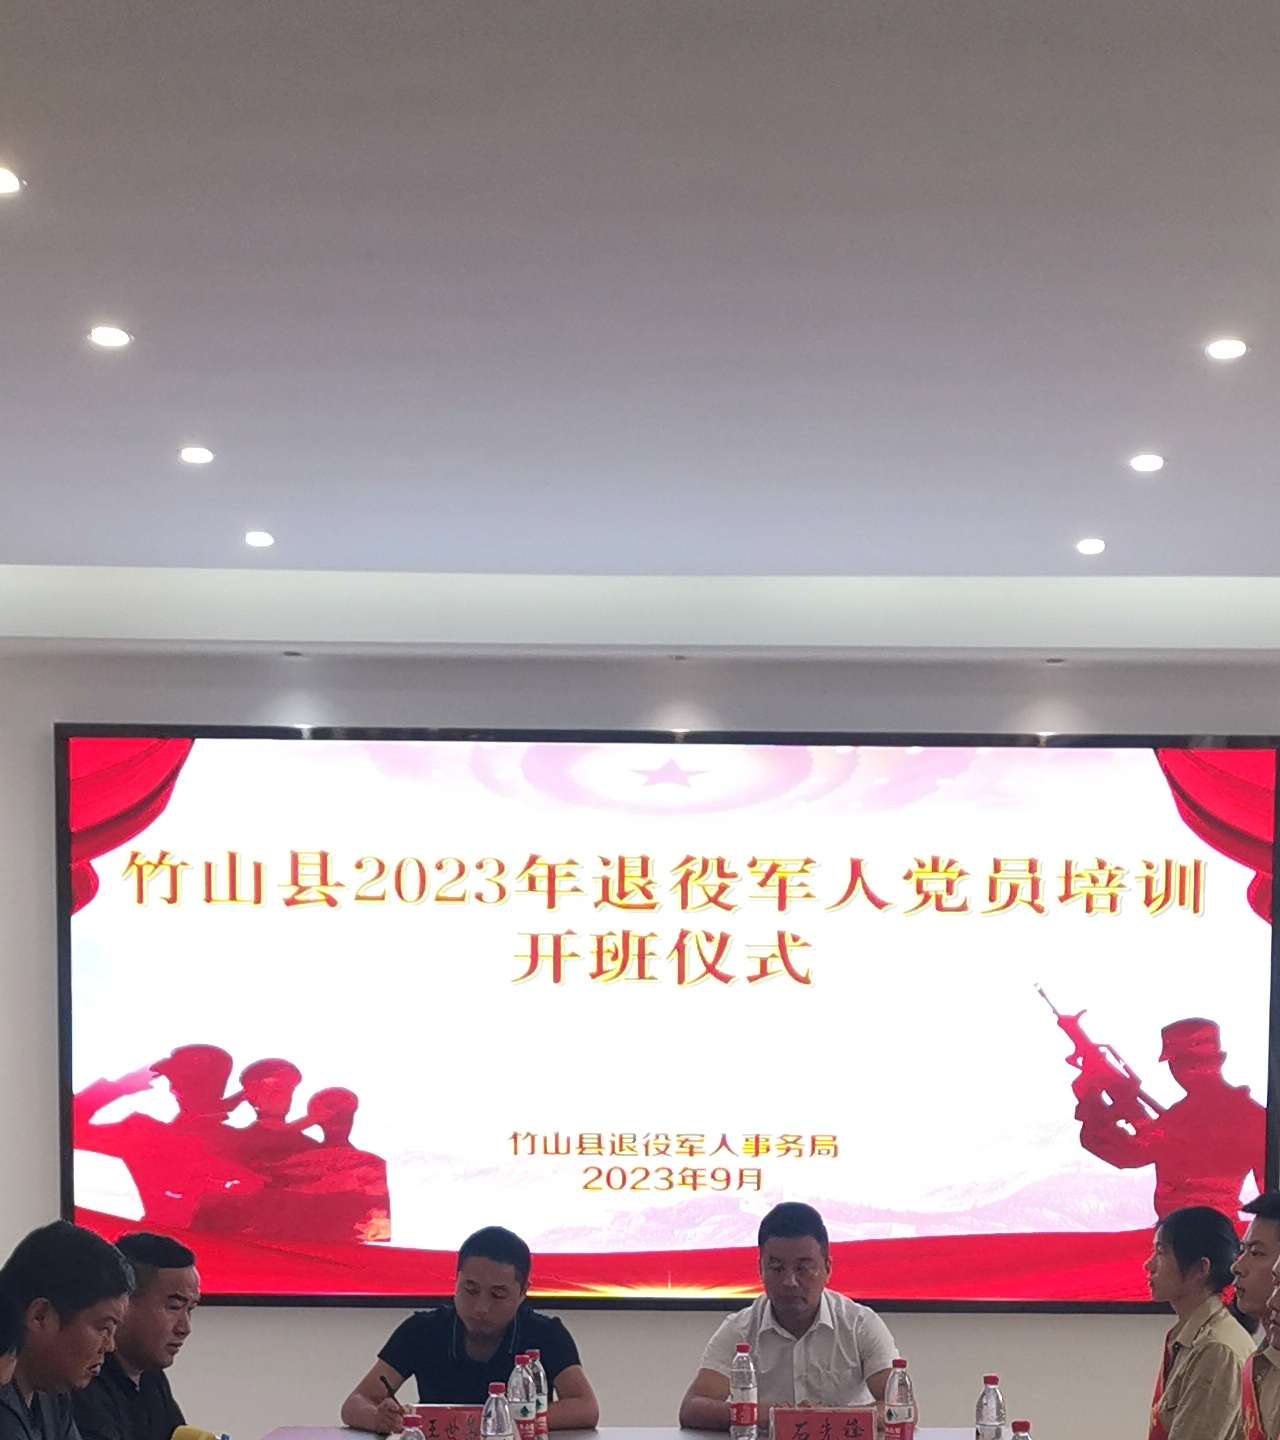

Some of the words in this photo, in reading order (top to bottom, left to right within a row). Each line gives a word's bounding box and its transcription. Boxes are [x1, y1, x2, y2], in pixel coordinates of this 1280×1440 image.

[121, 849, 1206, 916] 竹山县2023年退役军人党员培训
[511, 929, 815, 985] 开班仪式
[508, 1131, 839, 1158] 竹山县退役军人事务局
[582, 1166, 762, 1192] 2023年9月
